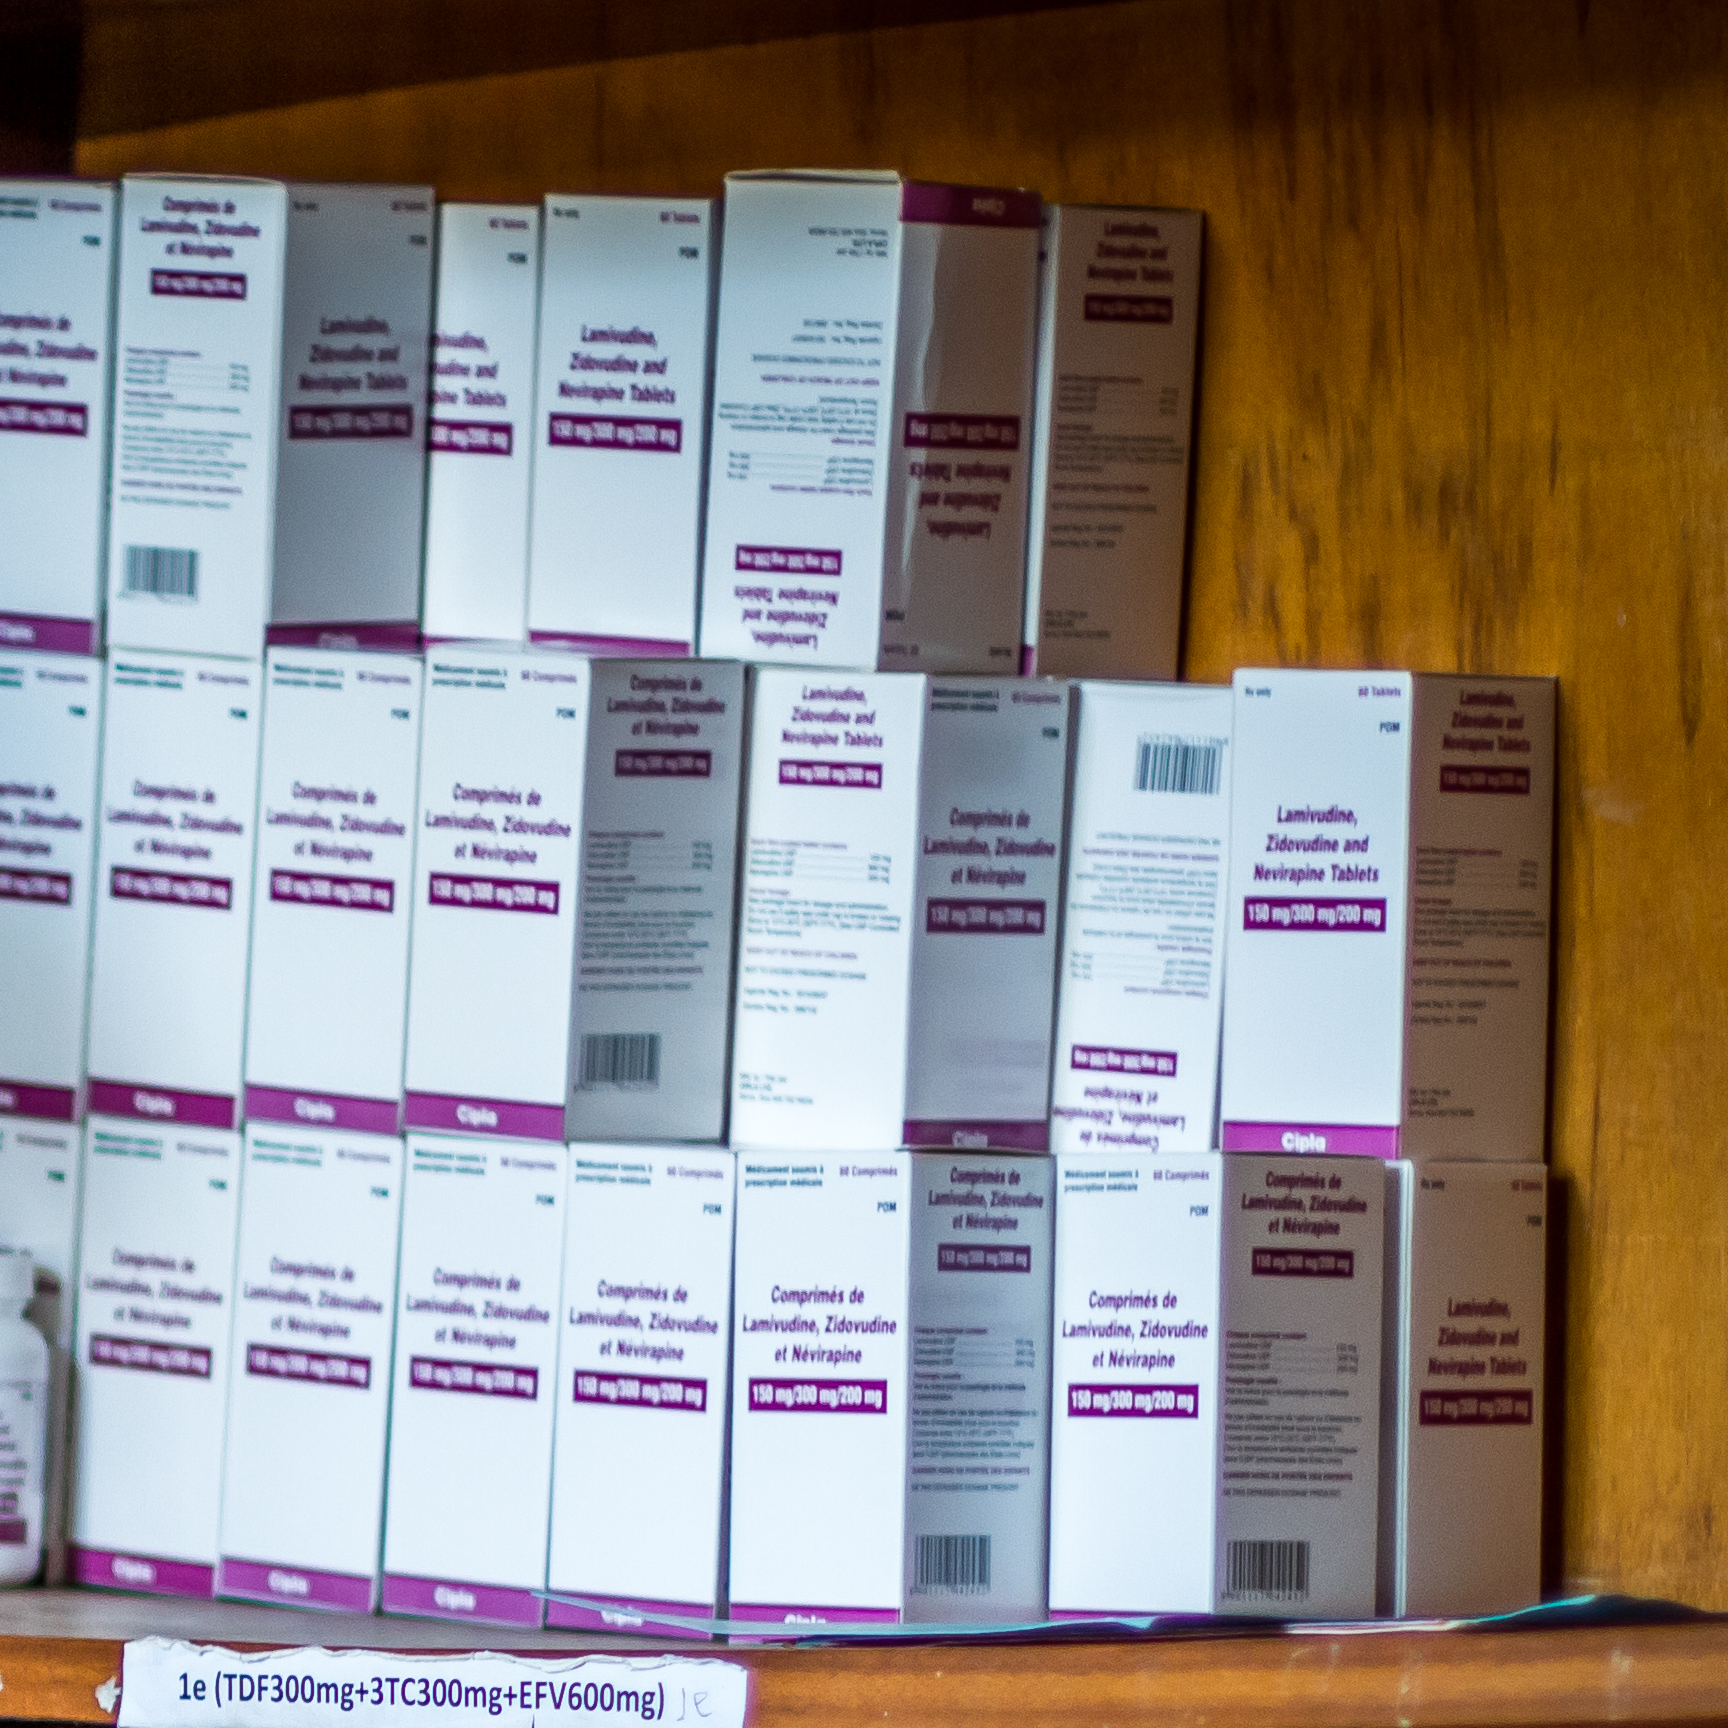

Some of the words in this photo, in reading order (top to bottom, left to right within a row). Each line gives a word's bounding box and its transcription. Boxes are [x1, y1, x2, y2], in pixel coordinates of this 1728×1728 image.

[673, 210, 700, 223] Tablets
[582, 324, 658, 348] Lamivudine,
[570, 352, 638, 372] Zidovudine
[644, 356, 667, 374] and
[559, 381, 624, 404] Nevirapine
[630, 383, 675, 403] Tablets
[802, 685, 867, 705] Lamivudine,
[1372, 686, 1401, 697] Tablets
[792, 706, 850, 723] Zidovudine
[855, 710, 876, 724] and
[1380, 721, 1400, 733] POM
[782, 729, 838, 750] Nevirapine
[844, 730, 883, 747] Tablets
[454, 783, 521, 805] Comprimés
[528, 789, 540, 805] de
[426, 810, 496, 834] Lamivudine,
[504, 815, 571, 836] Zidovudine
[950, 807, 1012, 831] Comprimés
[1277, 804, 1357, 827] Lamivudine,
[996, 836, 1055, 858] Zidovudine
[1266, 833, 1339, 853] Zidovudine
[1344, 835, 1369, 853] and
[1254, 862, 1325, 887] Nevirapine
[1331, 863, 1379, 882] Tablets
[1247, 903, 1269, 922] 150
[1362, 908, 1381, 927] mg
[1281, 1131, 1326, 1153] Cipla
[852, 1165, 897, 1179] Comprimés
[951, 1166, 1005, 1190] Comprimés
[1009, 1167, 1020, 1185] de
[1165, 1170, 1209, 1184] Comprimés
[1266, 1171, 1325, 1197] Comprimés
[1329, 1172, 1341, 1189] de
[703, 1203, 721, 1214] POM
[877, 1202, 896, 1212] POM
[990, 1191, 1043, 1208] Zidovudine
[1190, 1205, 1208, 1217] POM
[1310, 1195, 1367, 1213] Zidovudine
[1268, 1218, 1279, 1234] et
[1283, 1218, 1340, 1238] Névirapine
[598, 1279, 667, 1302] Comprimés
[673, 1285, 687, 1303] de
[772, 1284, 844, 1308] Comprimés
[849, 1285, 864, 1304] de
[1089, 1289, 1158, 1313] Comprimés
[1163, 1290, 1177, 1308] de
[1448, 1297, 1511, 1319] Lamivudine,
[570, 1307, 642, 1332] Lamivudine,
[649, 1311, 718, 1334] Zidovudine
[743, 1314, 819, 1337] Lamivudine,
[825, 1315, 896, 1333] Zidovudine
[1062, 1320, 1135, 1343] Lamivudine,
[1140, 1320, 1208, 1338] Zidovudine
[1438, 1327, 1496, 1346] Zidovudine
[1499, 1328, 1519, 1346] and
[600, 1339, 611, 1355] et
[617, 1340, 684, 1363] Névirapine
[775, 1345, 787, 1363] et
[792, 1344, 862, 1368] Névirapine
[1093, 1351, 1104, 1367] et
[1109, 1349, 1175, 1372] Névirapine
[1428, 1356, 1486, 1379] Nevirapine
[1490, 1356, 1527, 1375] Tablets
[753, 1385, 773, 1404] 150
[775, 1385, 817, 1408] mg/300
[819, 1386, 862, 1409] mg/200
[864, 1390, 882, 1410] mg
[1072, 1390, 1091, 1409] 150
[1093, 1390, 1132, 1414] mg/300
[1135, 1391, 1175, 1414] mg/200
[1177, 1395, 1194, 1414] mg
[179, 1672, 206, 1702] 1e
[213, 1671, 665, 1720] (TDF300mg+3TC300mg+EFV600mg)
